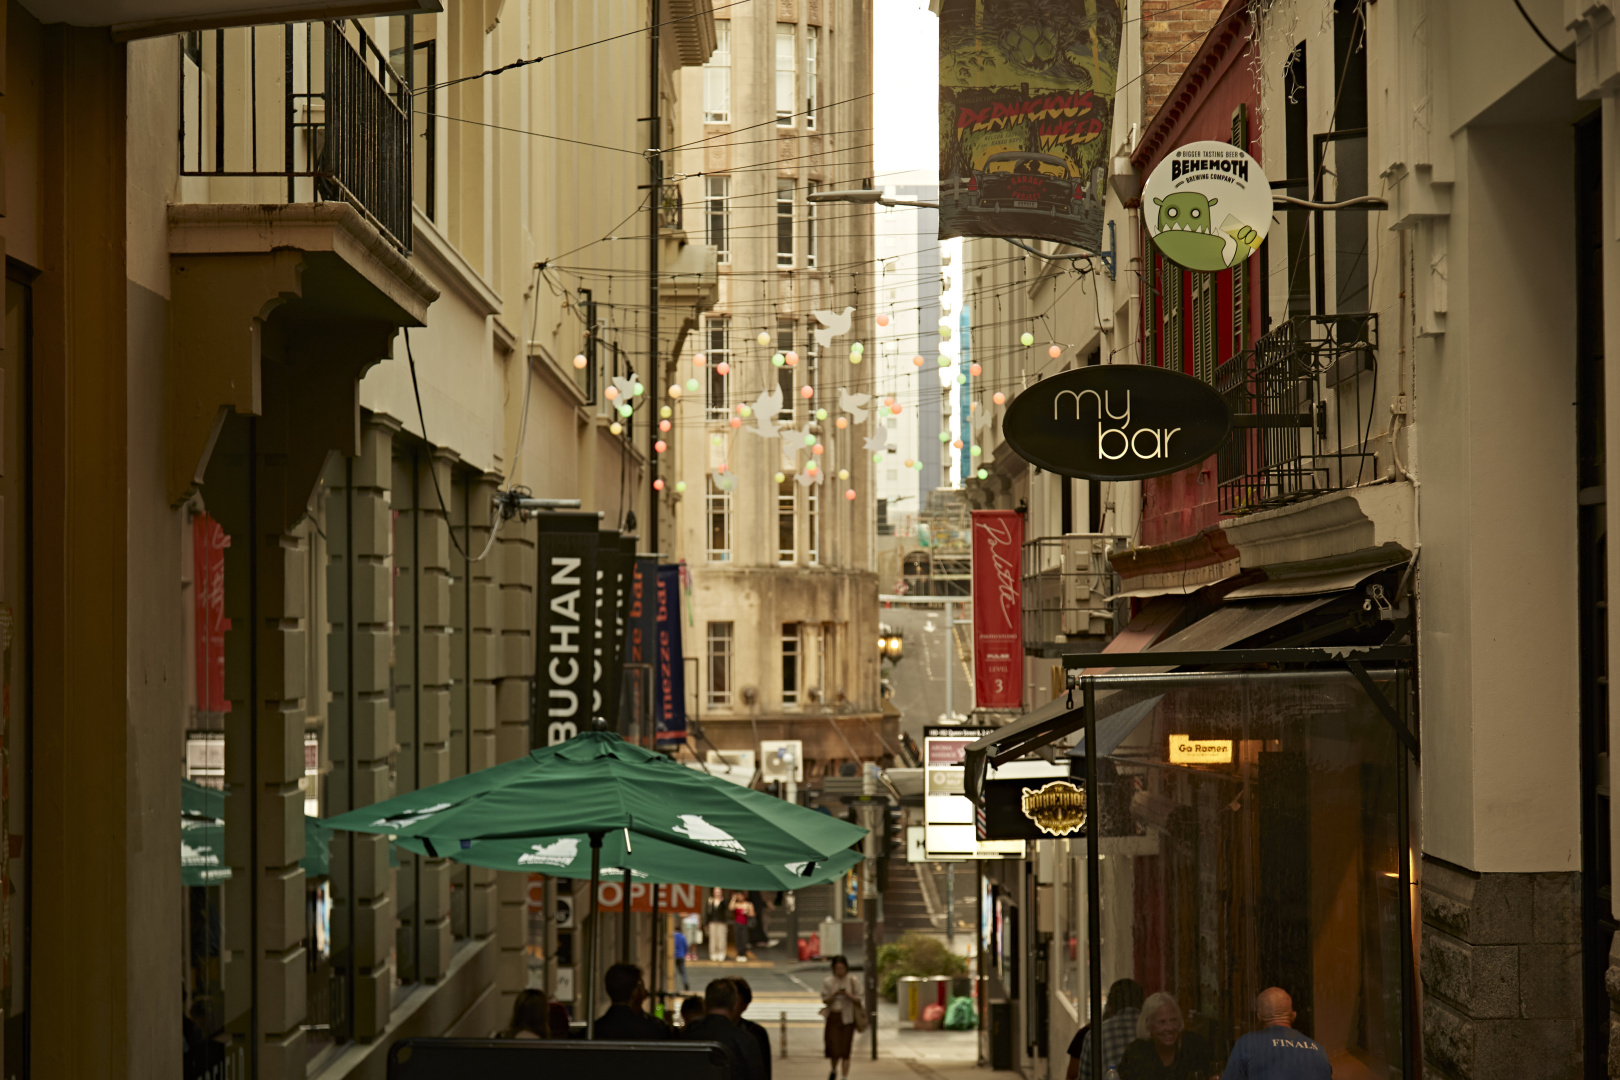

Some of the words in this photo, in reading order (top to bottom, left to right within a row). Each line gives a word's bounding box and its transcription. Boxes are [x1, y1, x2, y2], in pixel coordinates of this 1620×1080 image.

[957, 89, 1095, 143] PERNICIOUS
[1038, 118, 1103, 150] WEED
[1182, 150, 1201, 158] BIGGER
[1203, 150, 1224, 158] TASTING
[1010, 175, 1044, 187] GARAGE
[1171, 159, 1249, 183] BEHEMOTH
[1185, 173, 1209, 184] BREWING
[1210, 173, 1235, 184] COMPANY
[1011, 190, 1041, 201] PROJECT
[1054, 389, 1131, 430] my
[1098, 421, 1182, 460] bar
[655, 575, 669, 623] bar
[547, 556, 582, 748] BUCHAN
[659, 630, 674, 721] mezze
[994, 678, 1004, 694] 3
[1178, 744, 1193, 753] Go
[597, 881, 696, 909] OPEN
[1271, 1038, 1319, 1051] FINALS
